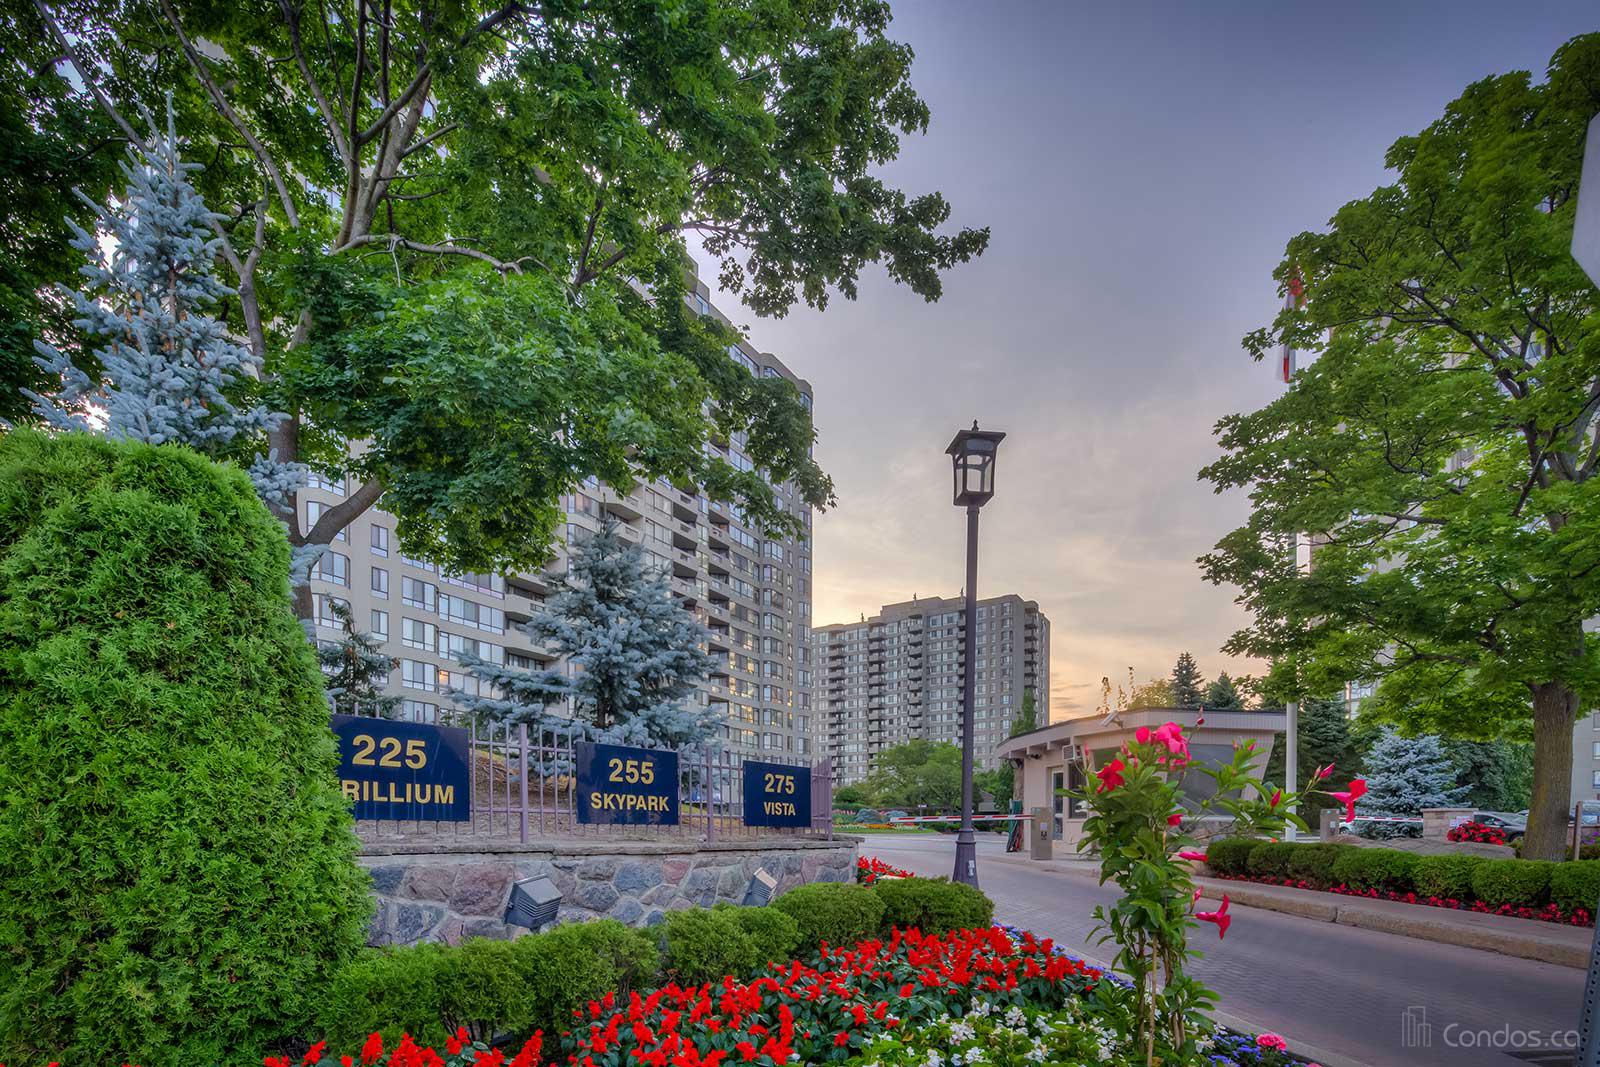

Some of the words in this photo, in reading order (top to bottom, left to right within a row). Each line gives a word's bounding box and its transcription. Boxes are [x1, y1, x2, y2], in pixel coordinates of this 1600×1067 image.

[352, 735, 427, 769] 225
[608, 758, 654, 785] 255
[338, 779, 454, 804] RILLIUM
[764, 773, 795, 794] 275
[590, 792, 670, 812] SKYPARK
[763, 802, 796, 816] VISTA
